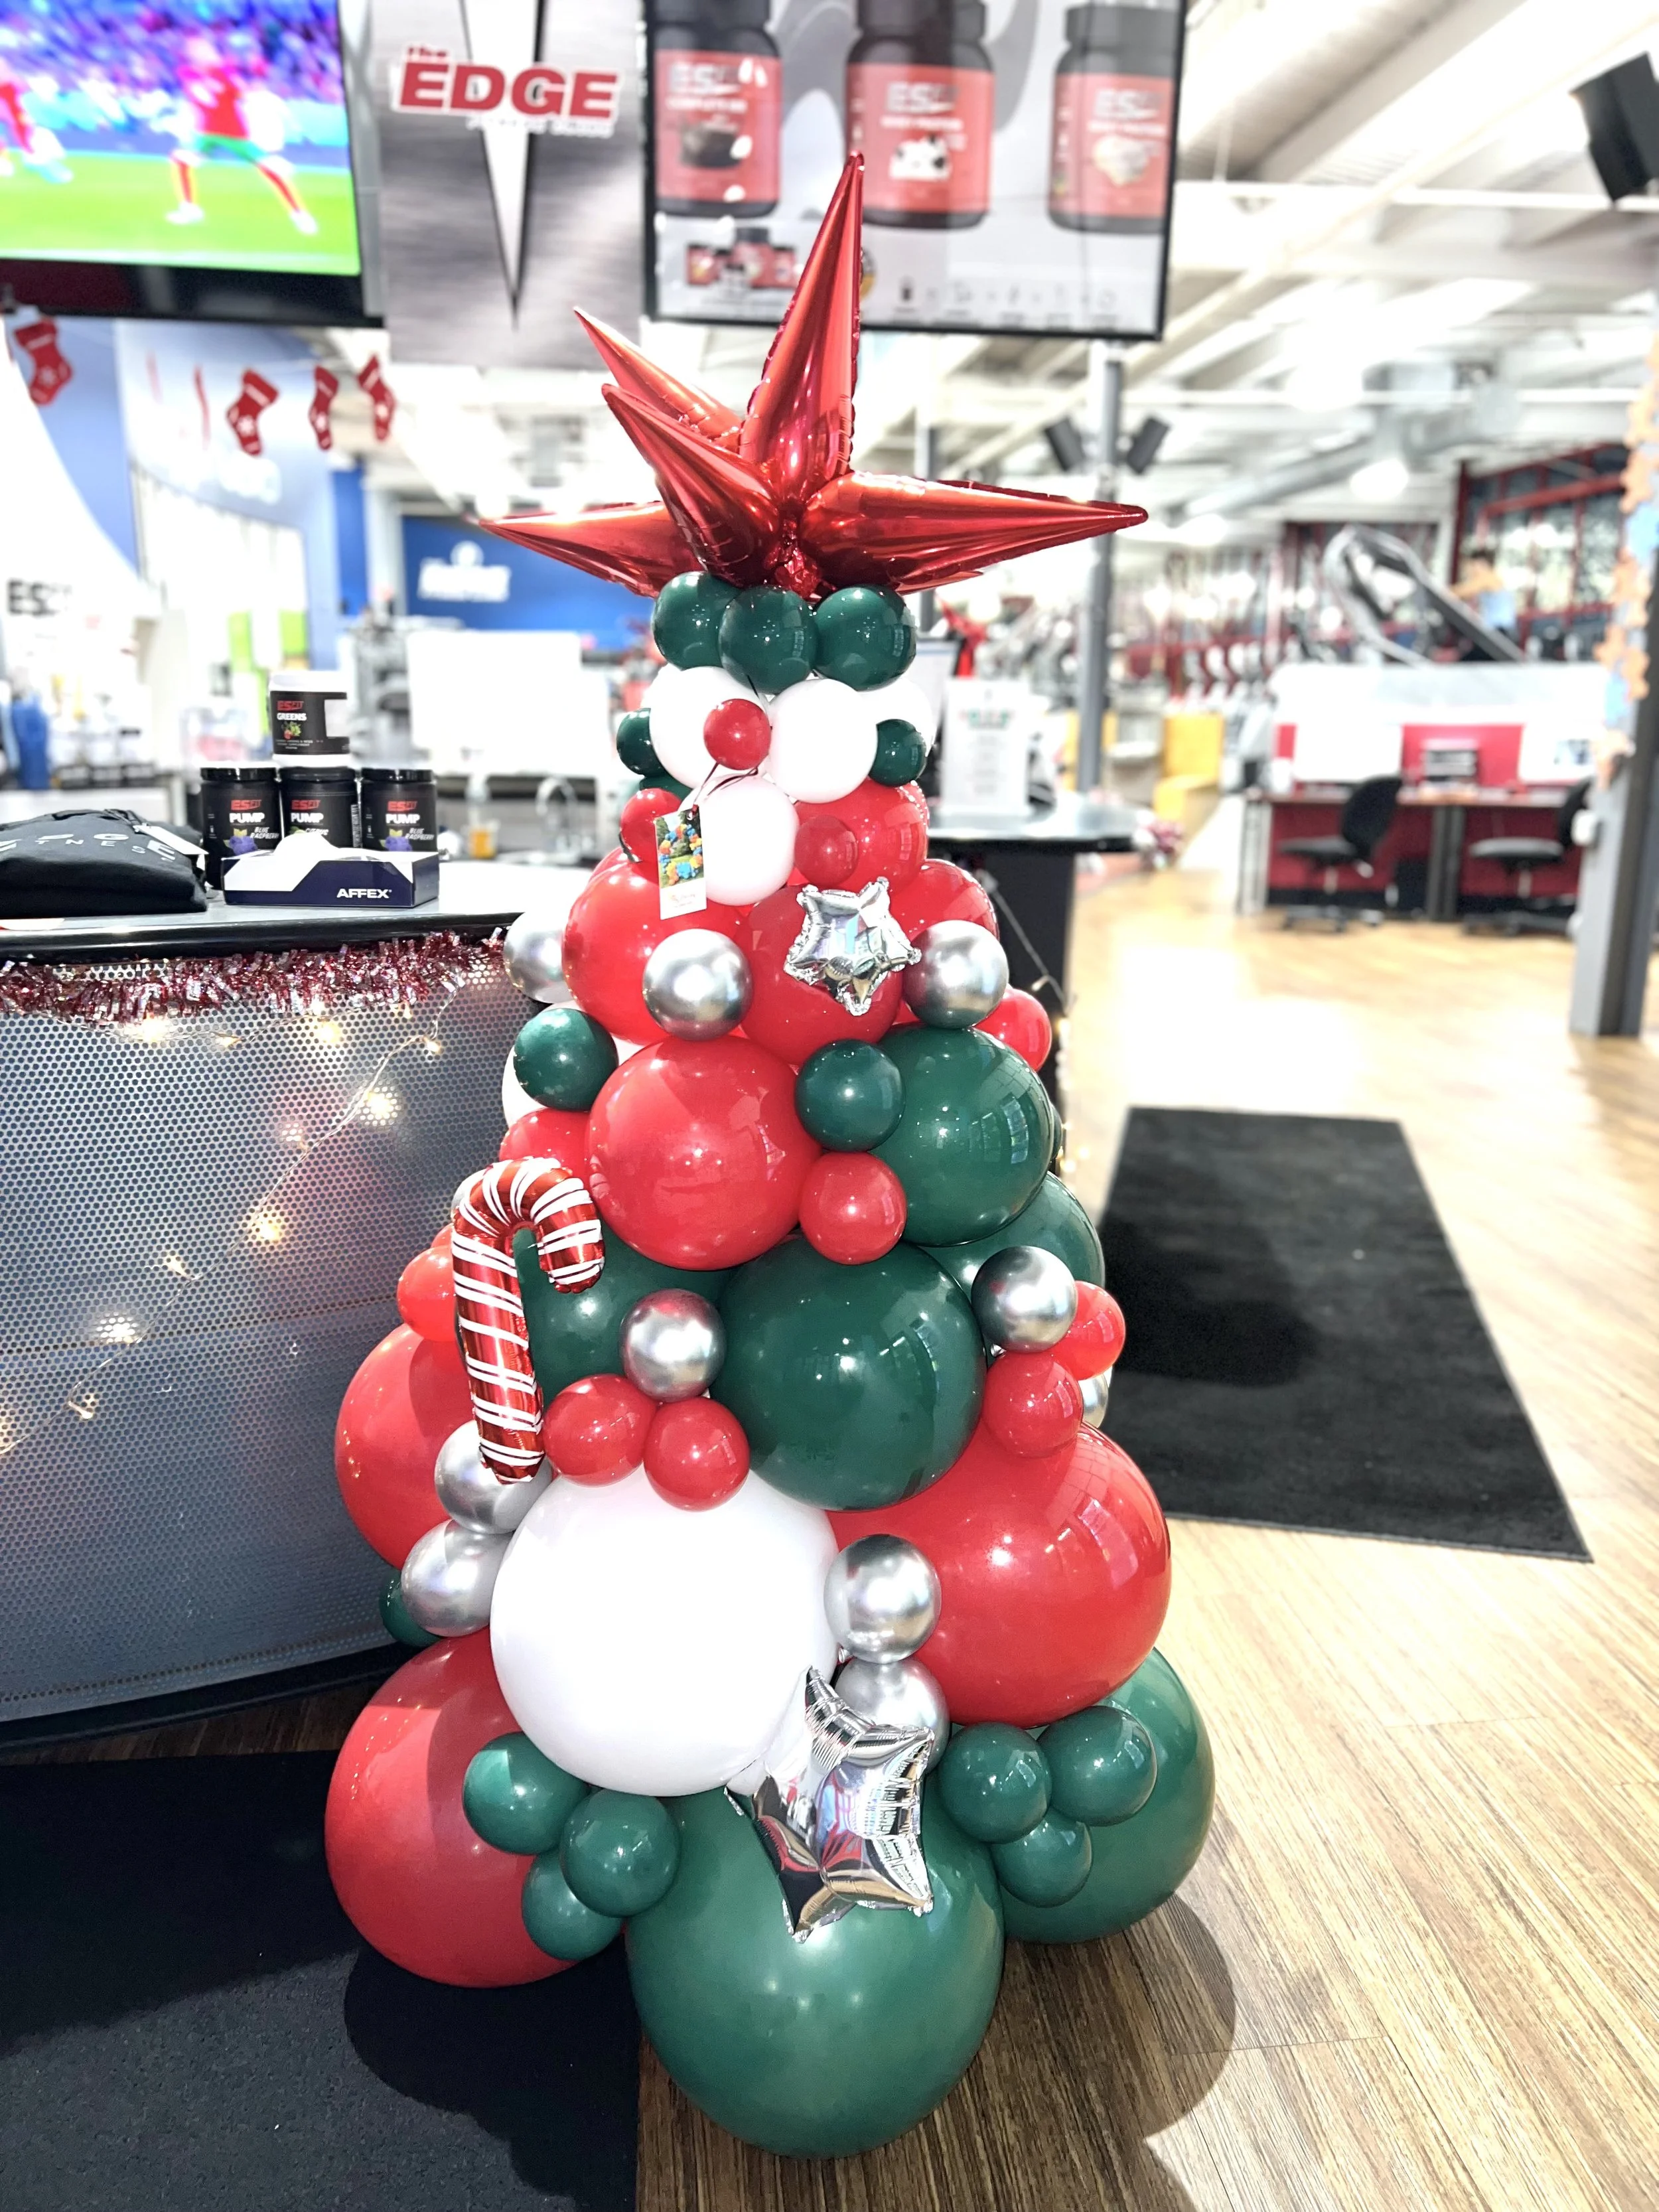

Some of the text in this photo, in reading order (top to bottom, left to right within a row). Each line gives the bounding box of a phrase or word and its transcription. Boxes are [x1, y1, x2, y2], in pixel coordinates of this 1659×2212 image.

[400, 62, 617, 119] EDGE
[277, 712, 307, 721] GREENS
[230, 812, 265, 823] PUMP
[291, 812, 324, 822] PUMP
[386, 814, 420, 824] PUMP
[336, 889, 390, 898] AFFEX
